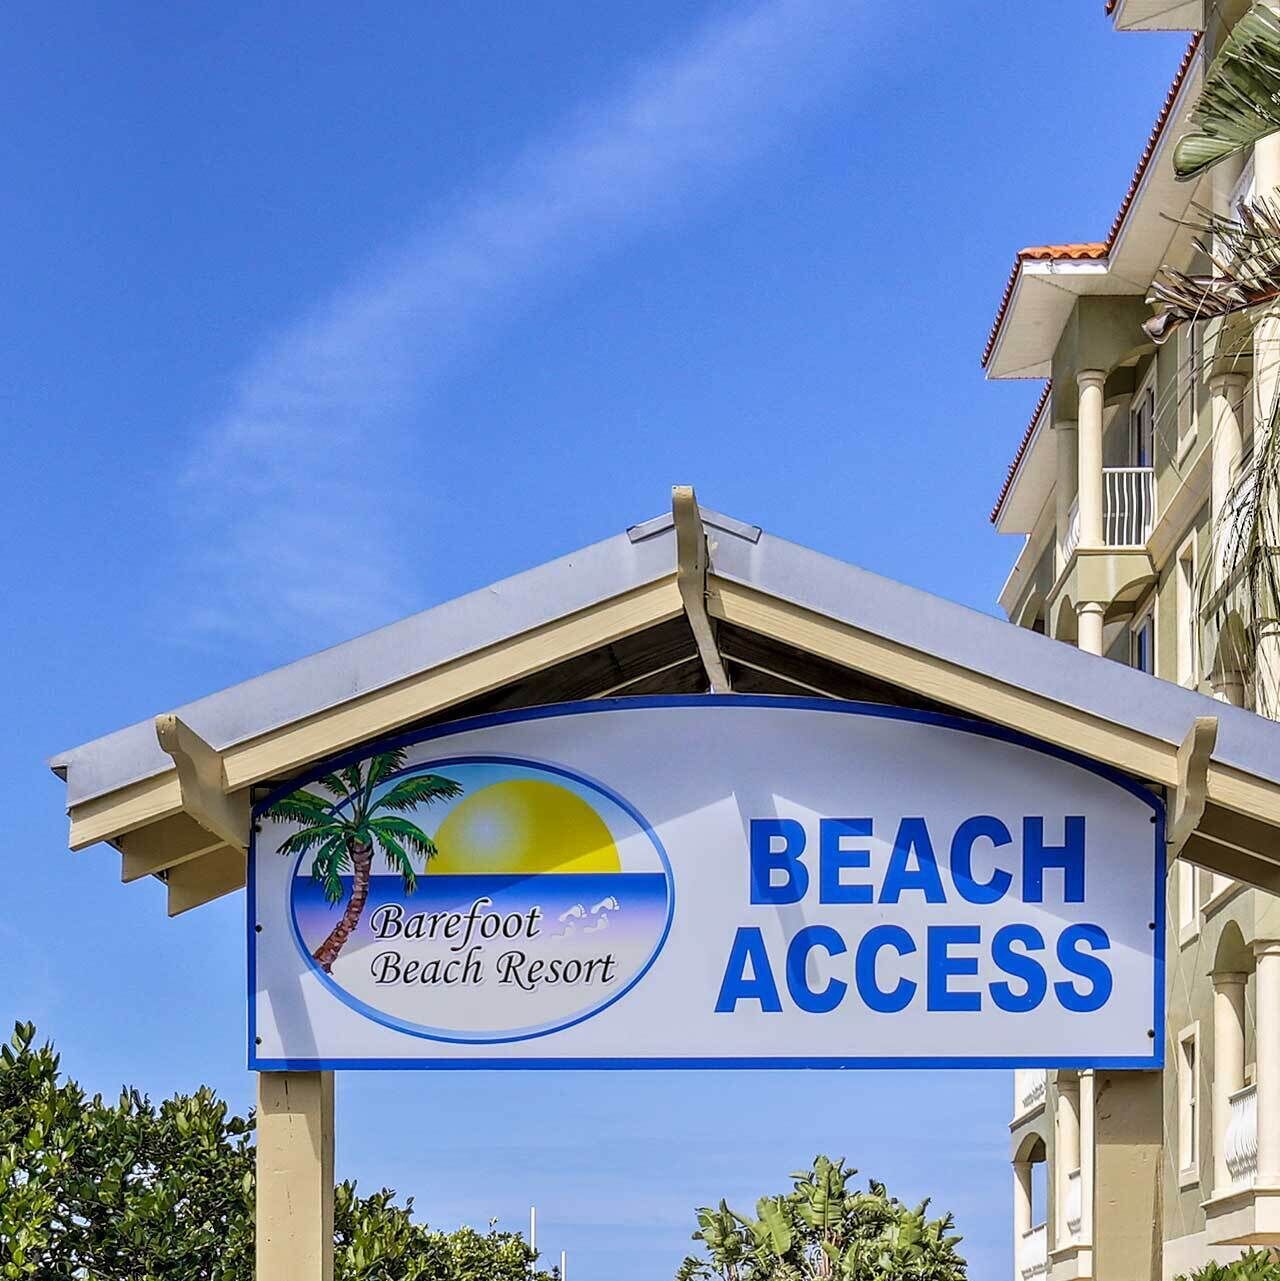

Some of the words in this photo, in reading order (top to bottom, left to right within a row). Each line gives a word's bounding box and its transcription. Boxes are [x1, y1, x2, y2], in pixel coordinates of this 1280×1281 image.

[750, 815, 1086, 905] BEACH
[371, 898, 541, 951] Barefoot
[371, 946, 483, 985] Beach
[496, 950, 615, 991] Resort
[714, 923, 1113, 1014] ACCESS
